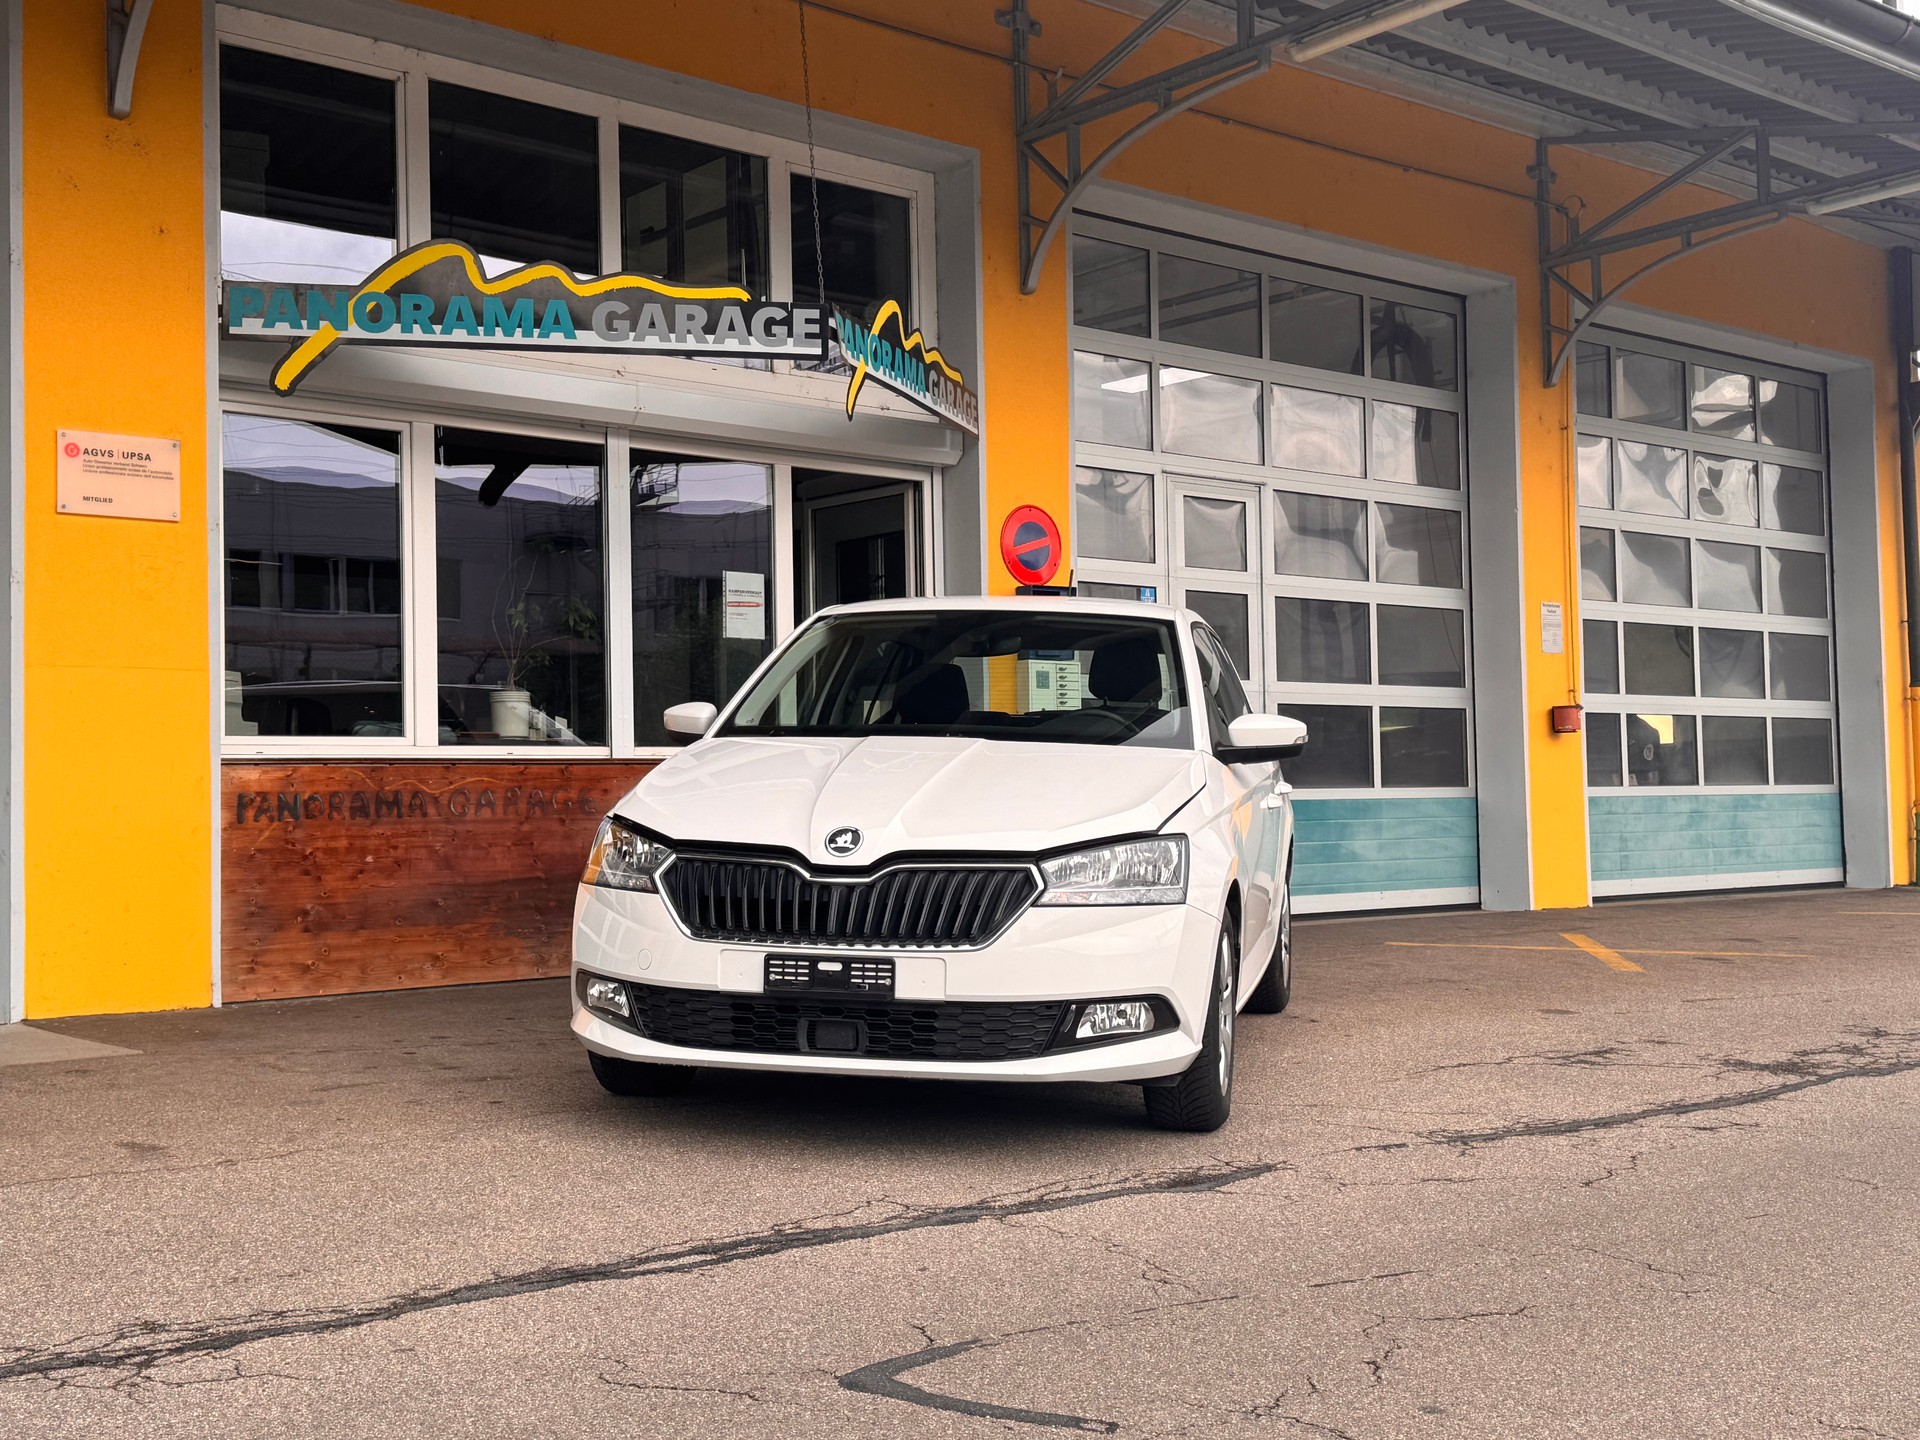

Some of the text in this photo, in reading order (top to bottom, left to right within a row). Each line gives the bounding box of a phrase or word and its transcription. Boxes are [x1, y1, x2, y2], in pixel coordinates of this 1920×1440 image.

[229, 286, 822, 348] PANORAMA GARAGE
[834, 310, 978, 429] PANORAMA GARAGE
[82, 448, 152, 461] AGVS UPSA
[82, 495, 113, 503] MITGLIED
[235, 786, 597, 824] PANORAMA GARAGE
